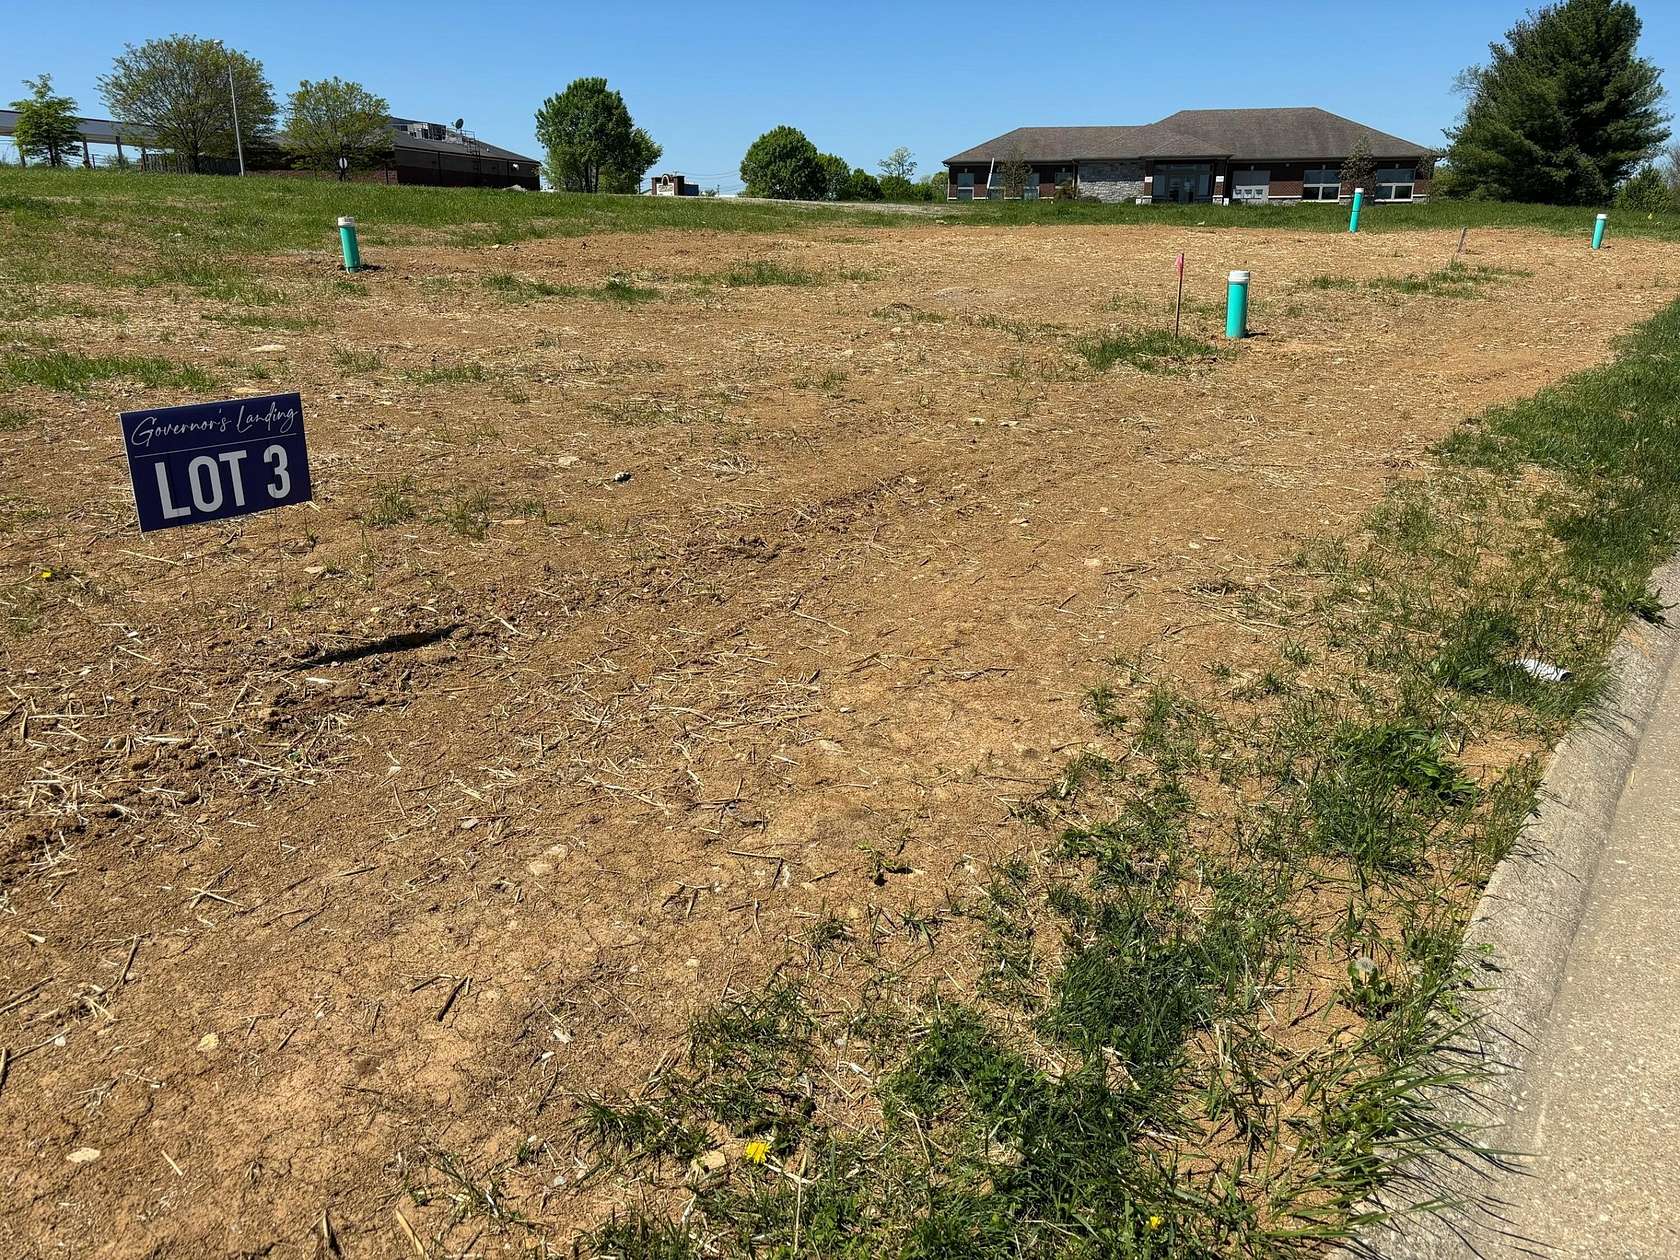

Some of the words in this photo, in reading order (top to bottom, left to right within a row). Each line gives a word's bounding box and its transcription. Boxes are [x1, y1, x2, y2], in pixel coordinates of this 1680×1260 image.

[131, 409, 231, 447] Governor's
[237, 401, 298, 433] Landing
[154, 449, 247, 520] LOT
[263, 444, 291, 499] 3
